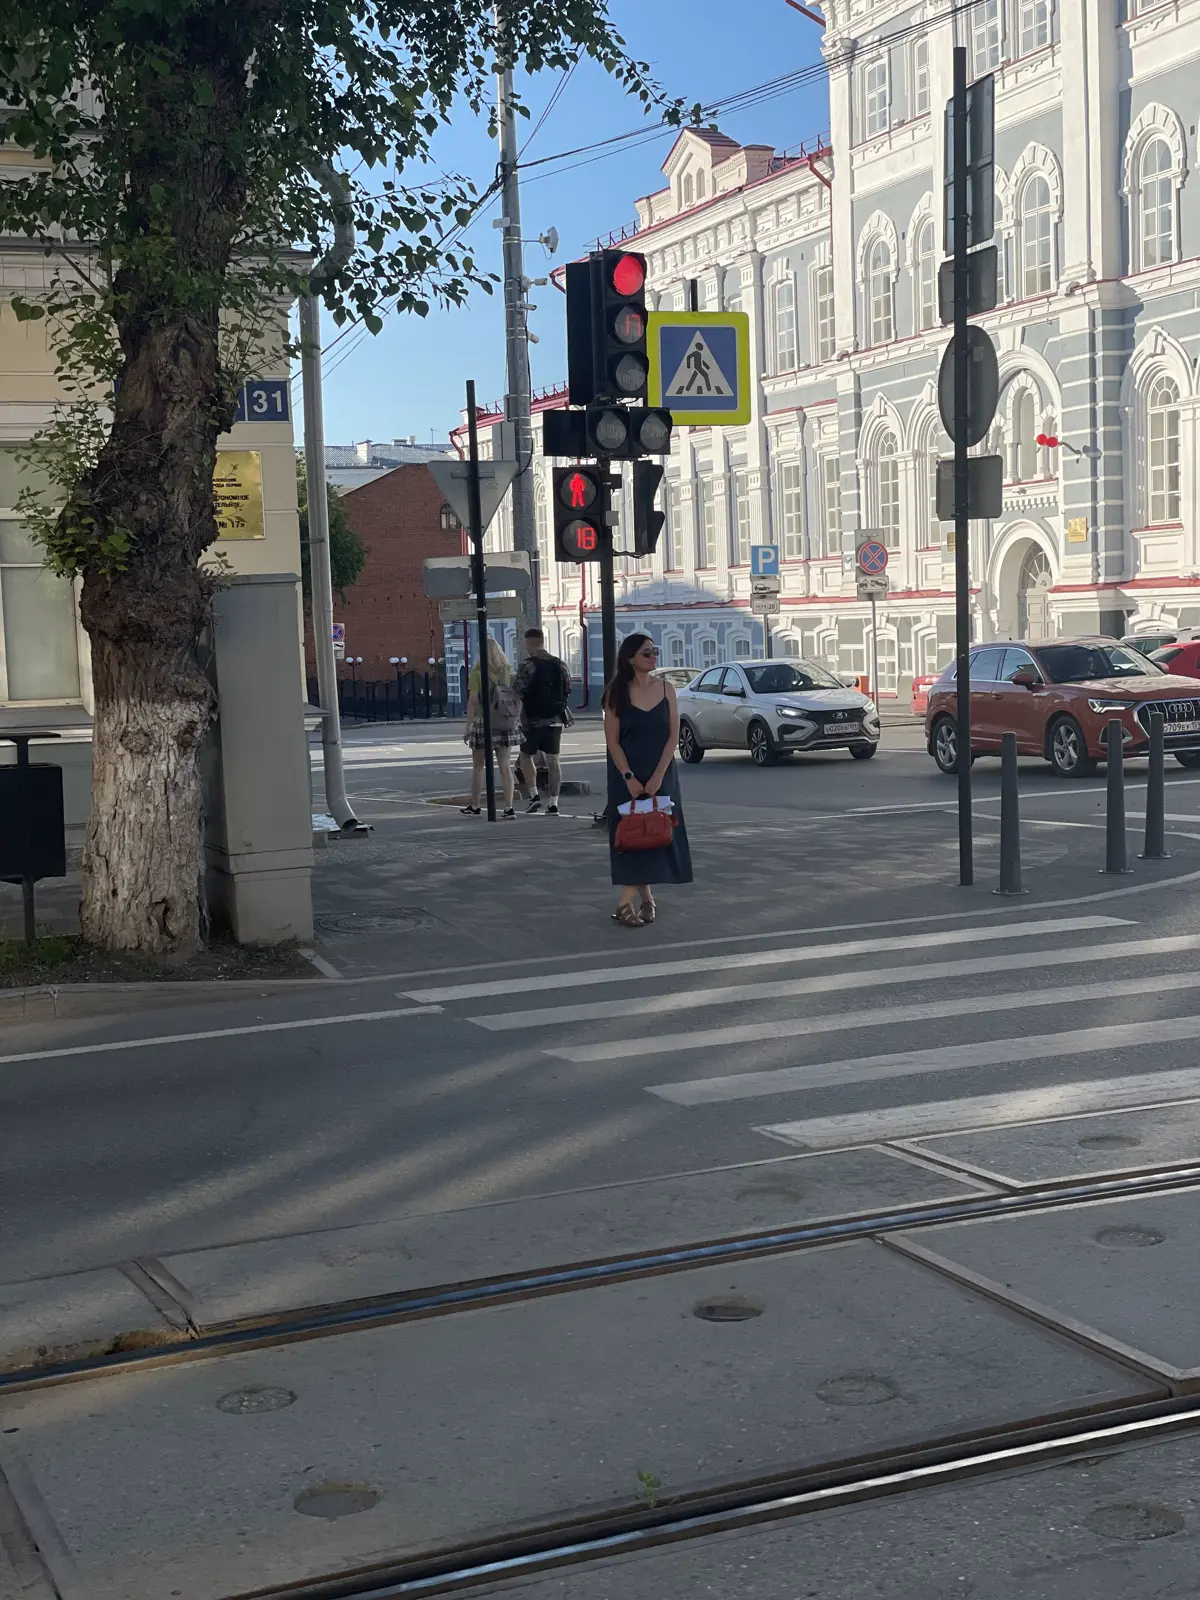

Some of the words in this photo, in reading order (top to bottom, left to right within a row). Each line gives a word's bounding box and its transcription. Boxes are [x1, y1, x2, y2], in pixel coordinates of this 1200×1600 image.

[252, 390, 282, 413] 31
[577, 526, 596, 550] 18
[758, 547, 775, 573] P
